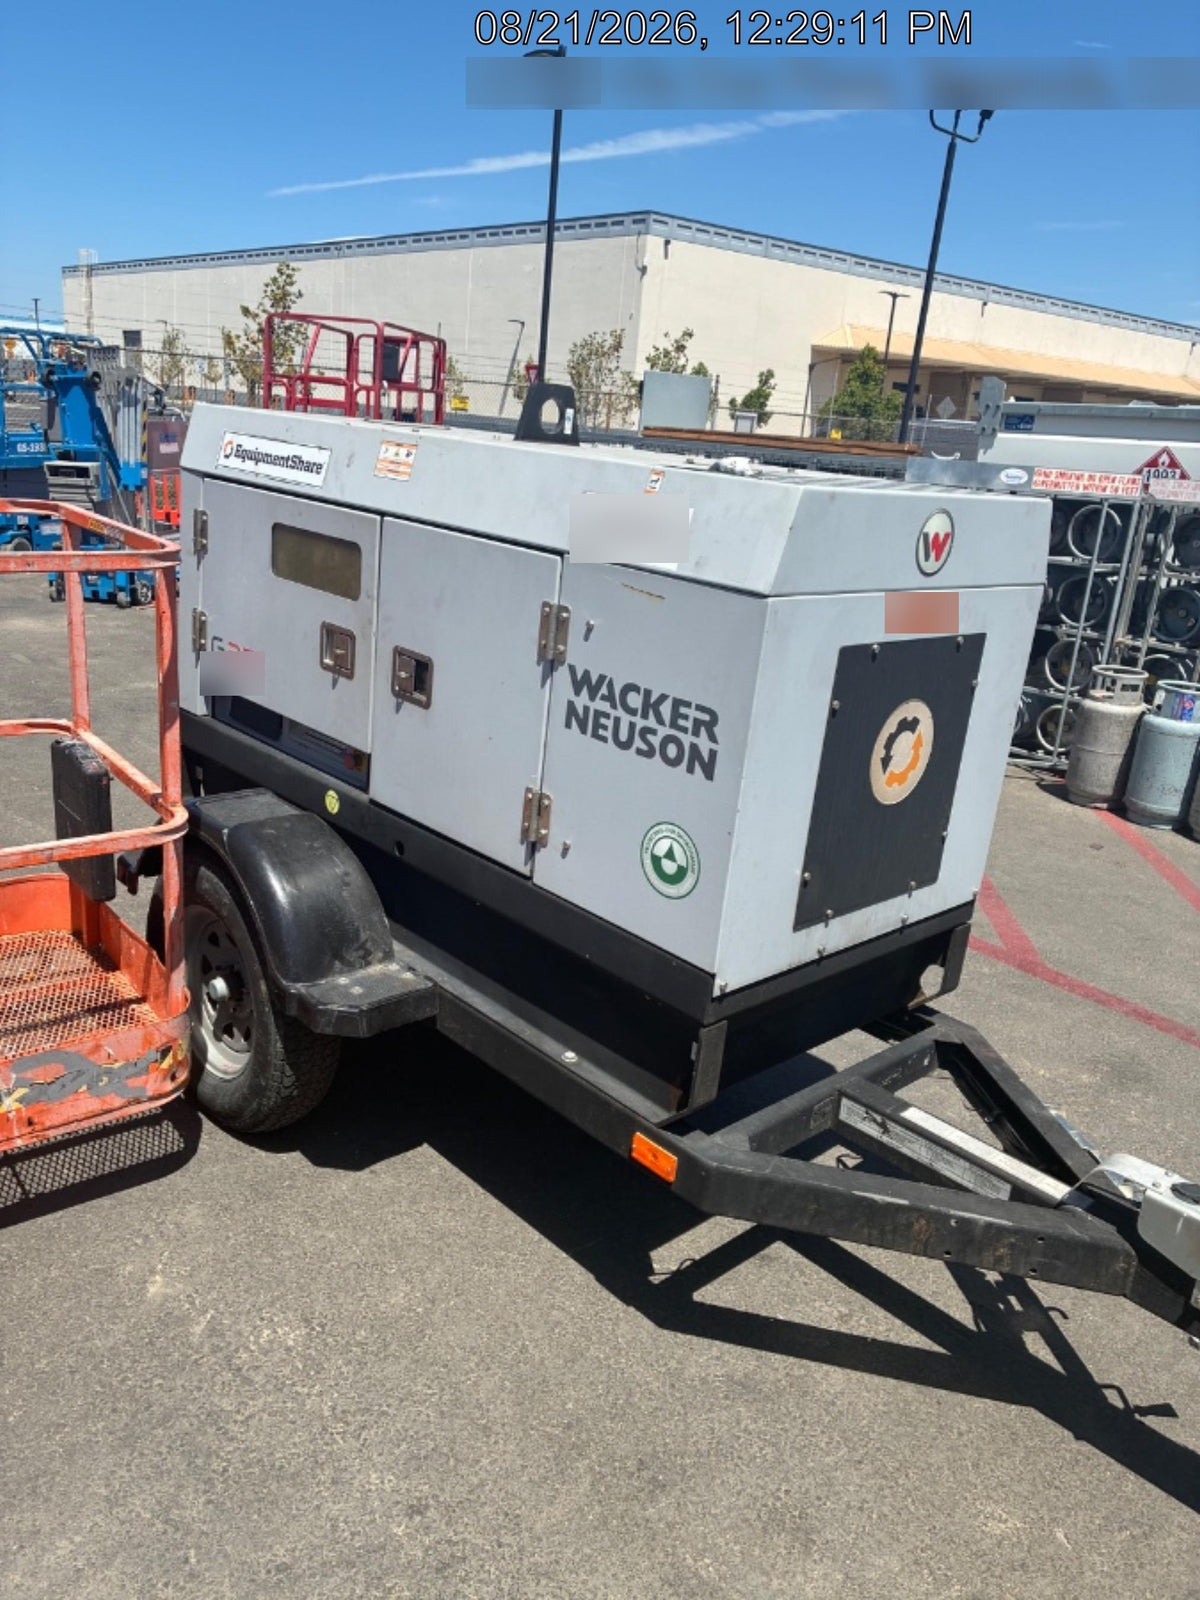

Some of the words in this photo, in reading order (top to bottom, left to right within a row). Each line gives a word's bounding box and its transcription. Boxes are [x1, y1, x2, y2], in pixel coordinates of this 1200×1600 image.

[234, 444, 323, 475] EquipmentShare
[923, 531, 951, 562] W
[567, 663, 719, 745] WACKER
[565, 699, 719, 782] NEUSON
